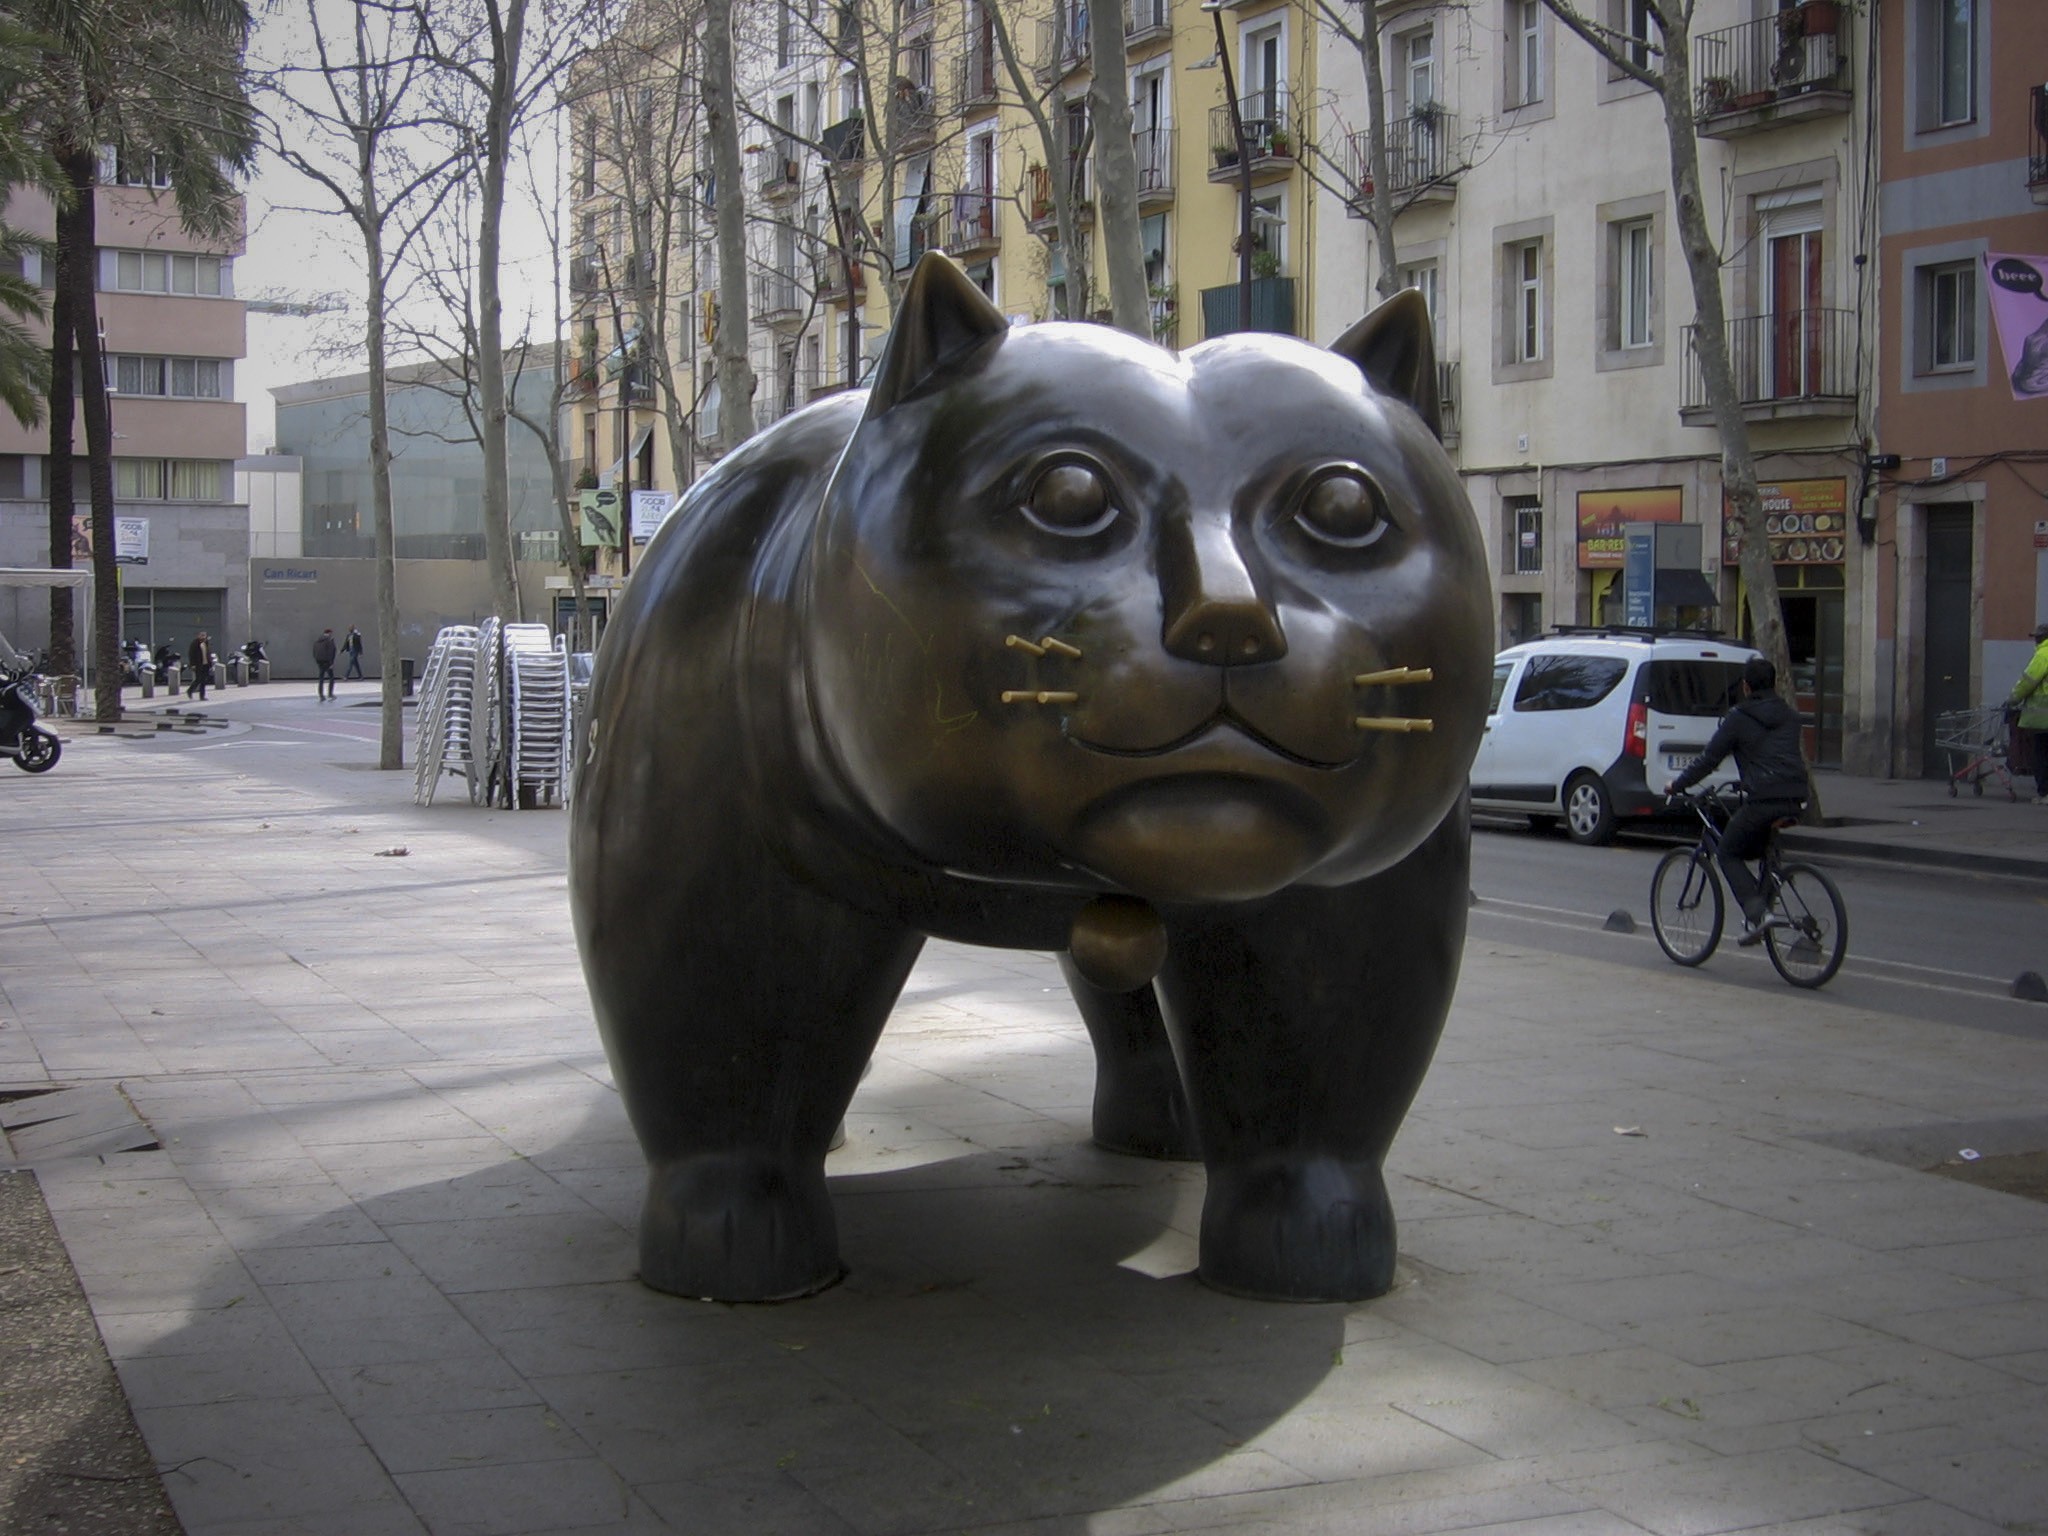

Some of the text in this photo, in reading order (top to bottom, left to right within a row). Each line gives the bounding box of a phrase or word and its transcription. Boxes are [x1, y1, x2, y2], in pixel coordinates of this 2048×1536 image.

[1761, 498, 1791, 511] HOUSE
[263, 568, 317, 579] Can Ricart
